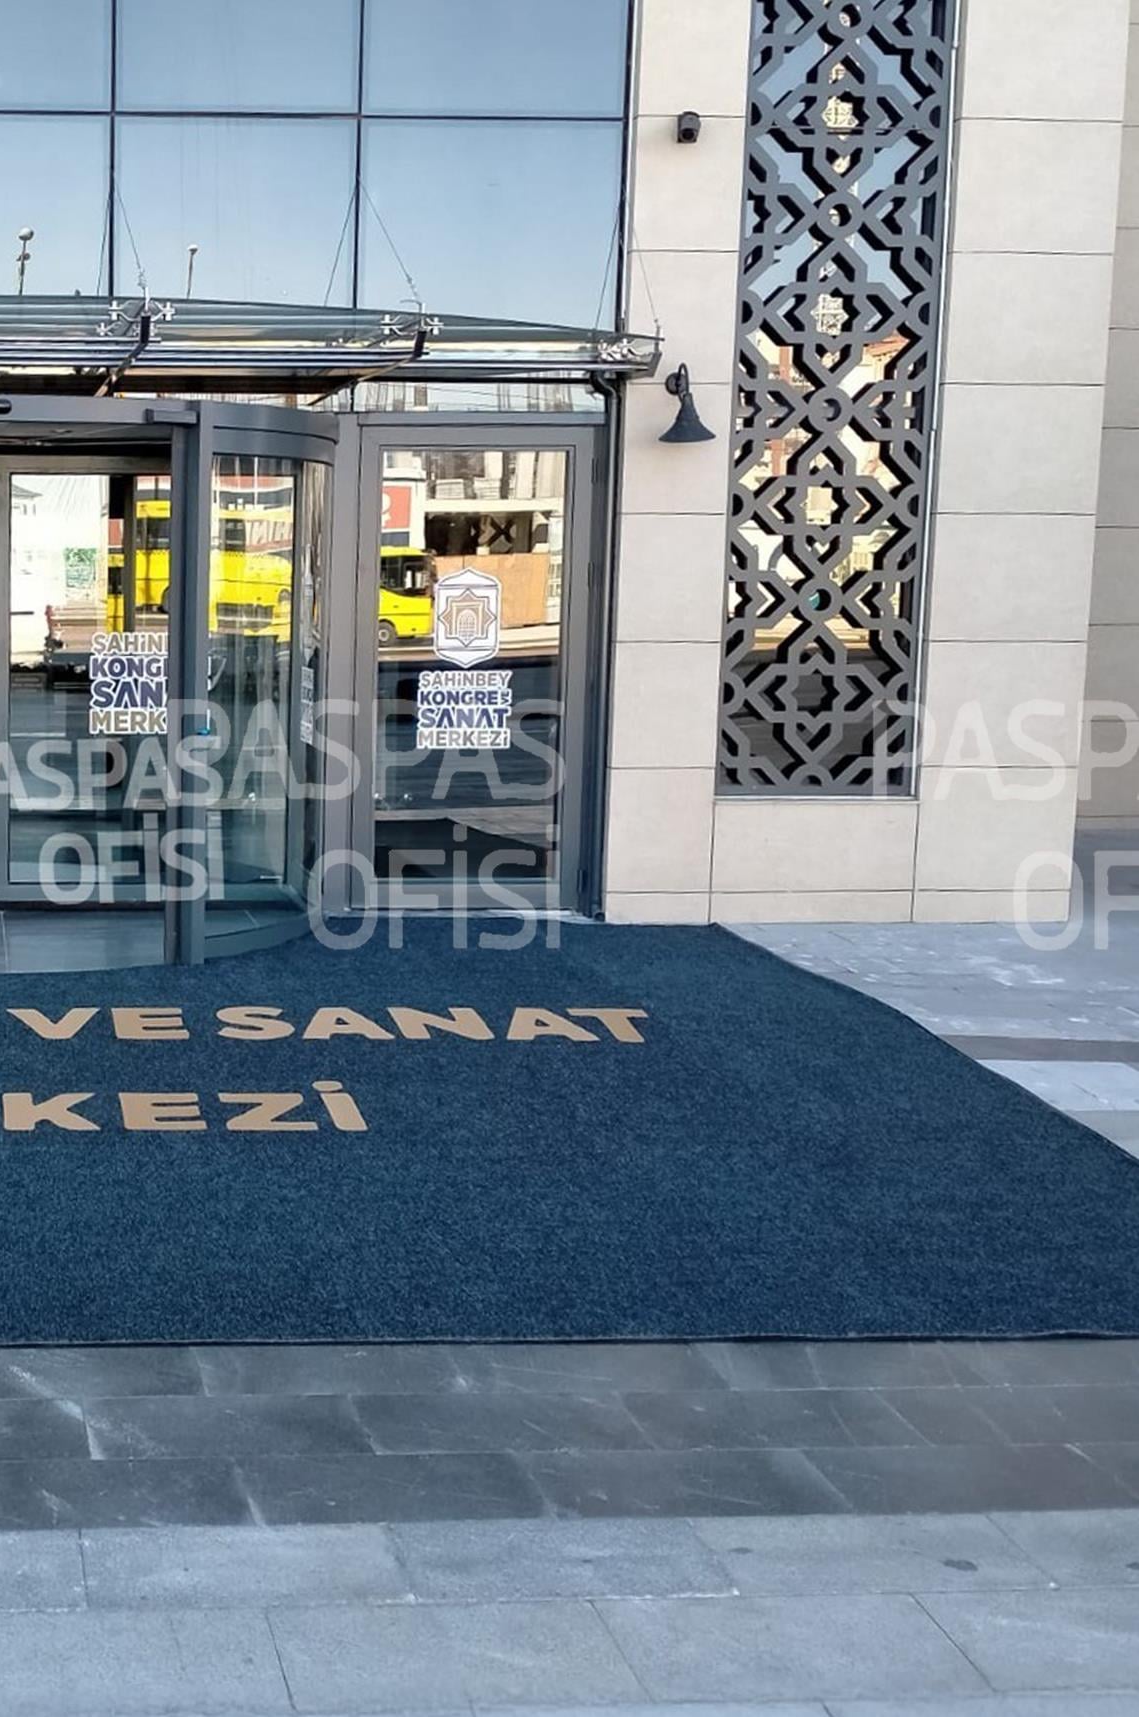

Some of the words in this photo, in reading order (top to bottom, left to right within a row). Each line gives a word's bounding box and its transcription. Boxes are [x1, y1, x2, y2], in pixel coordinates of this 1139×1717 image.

[92, 632, 168, 654] ŞAHİN
[91, 656, 168, 678] KONG
[91, 679, 167, 708] SAN
[419, 689, 499, 706] KONGRE
[91, 711, 167, 733] MERK
[419, 707, 511, 730] SANAT
[6, 1006, 191, 1041] VE
[215, 1006, 649, 1044] SANAT
